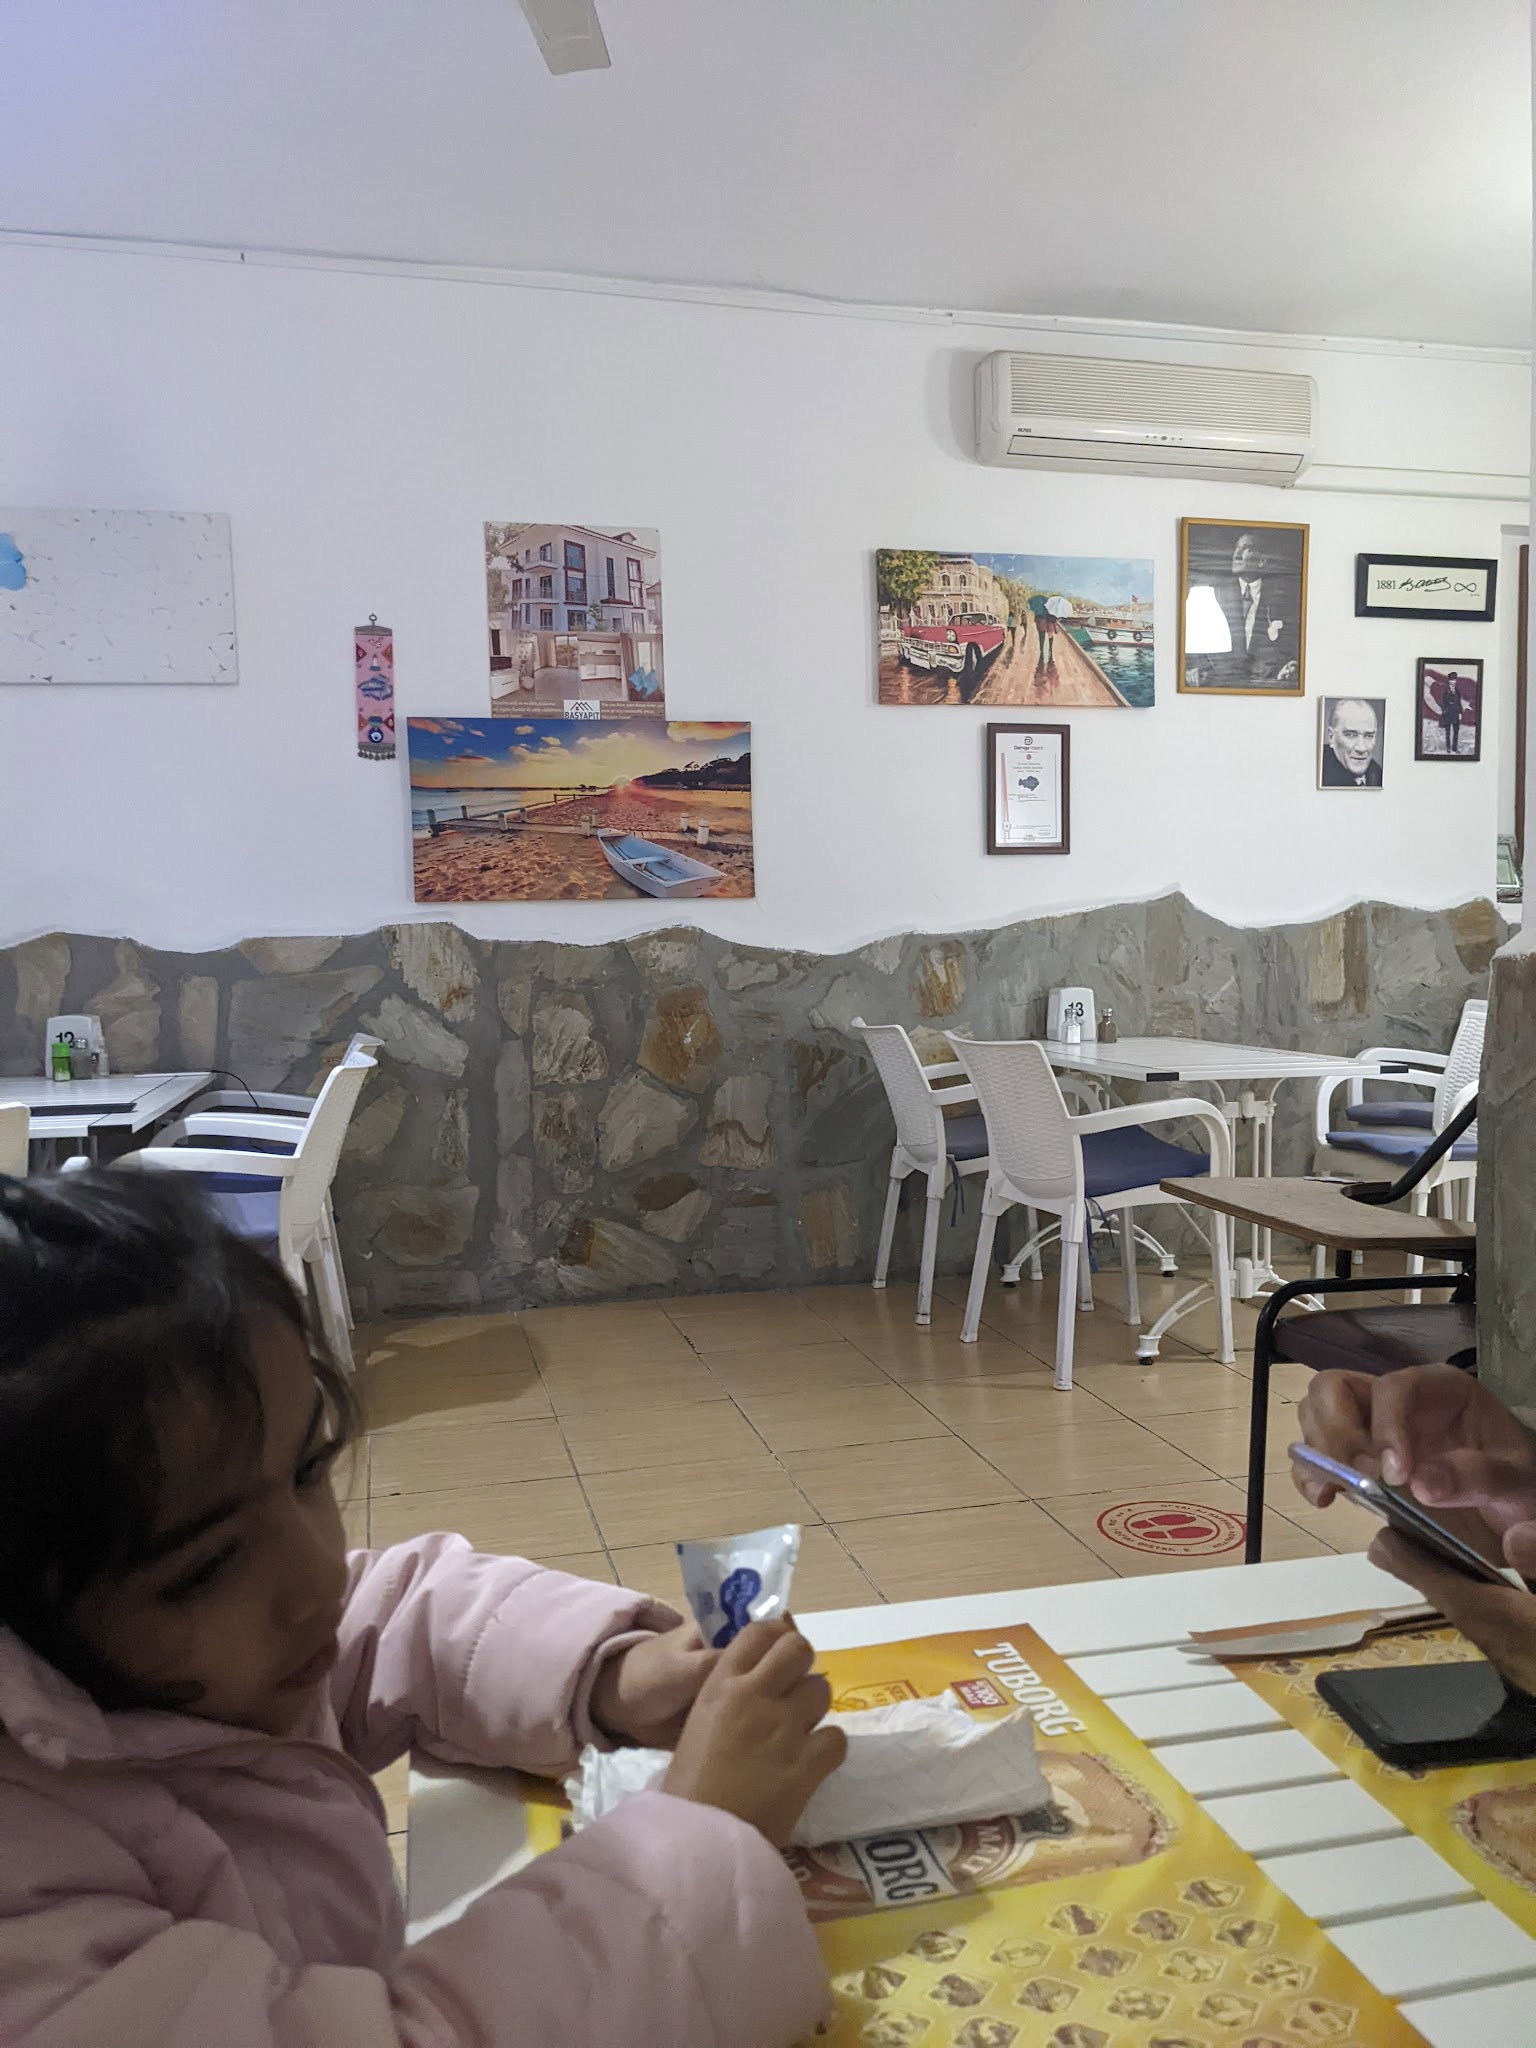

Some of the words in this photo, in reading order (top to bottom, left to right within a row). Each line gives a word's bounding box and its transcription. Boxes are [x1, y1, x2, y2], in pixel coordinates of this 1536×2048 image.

[1377, 579, 1396, 590] 1881
[973, 1641, 1087, 1737] TUBORG
[866, 1838, 940, 1901] ORG
